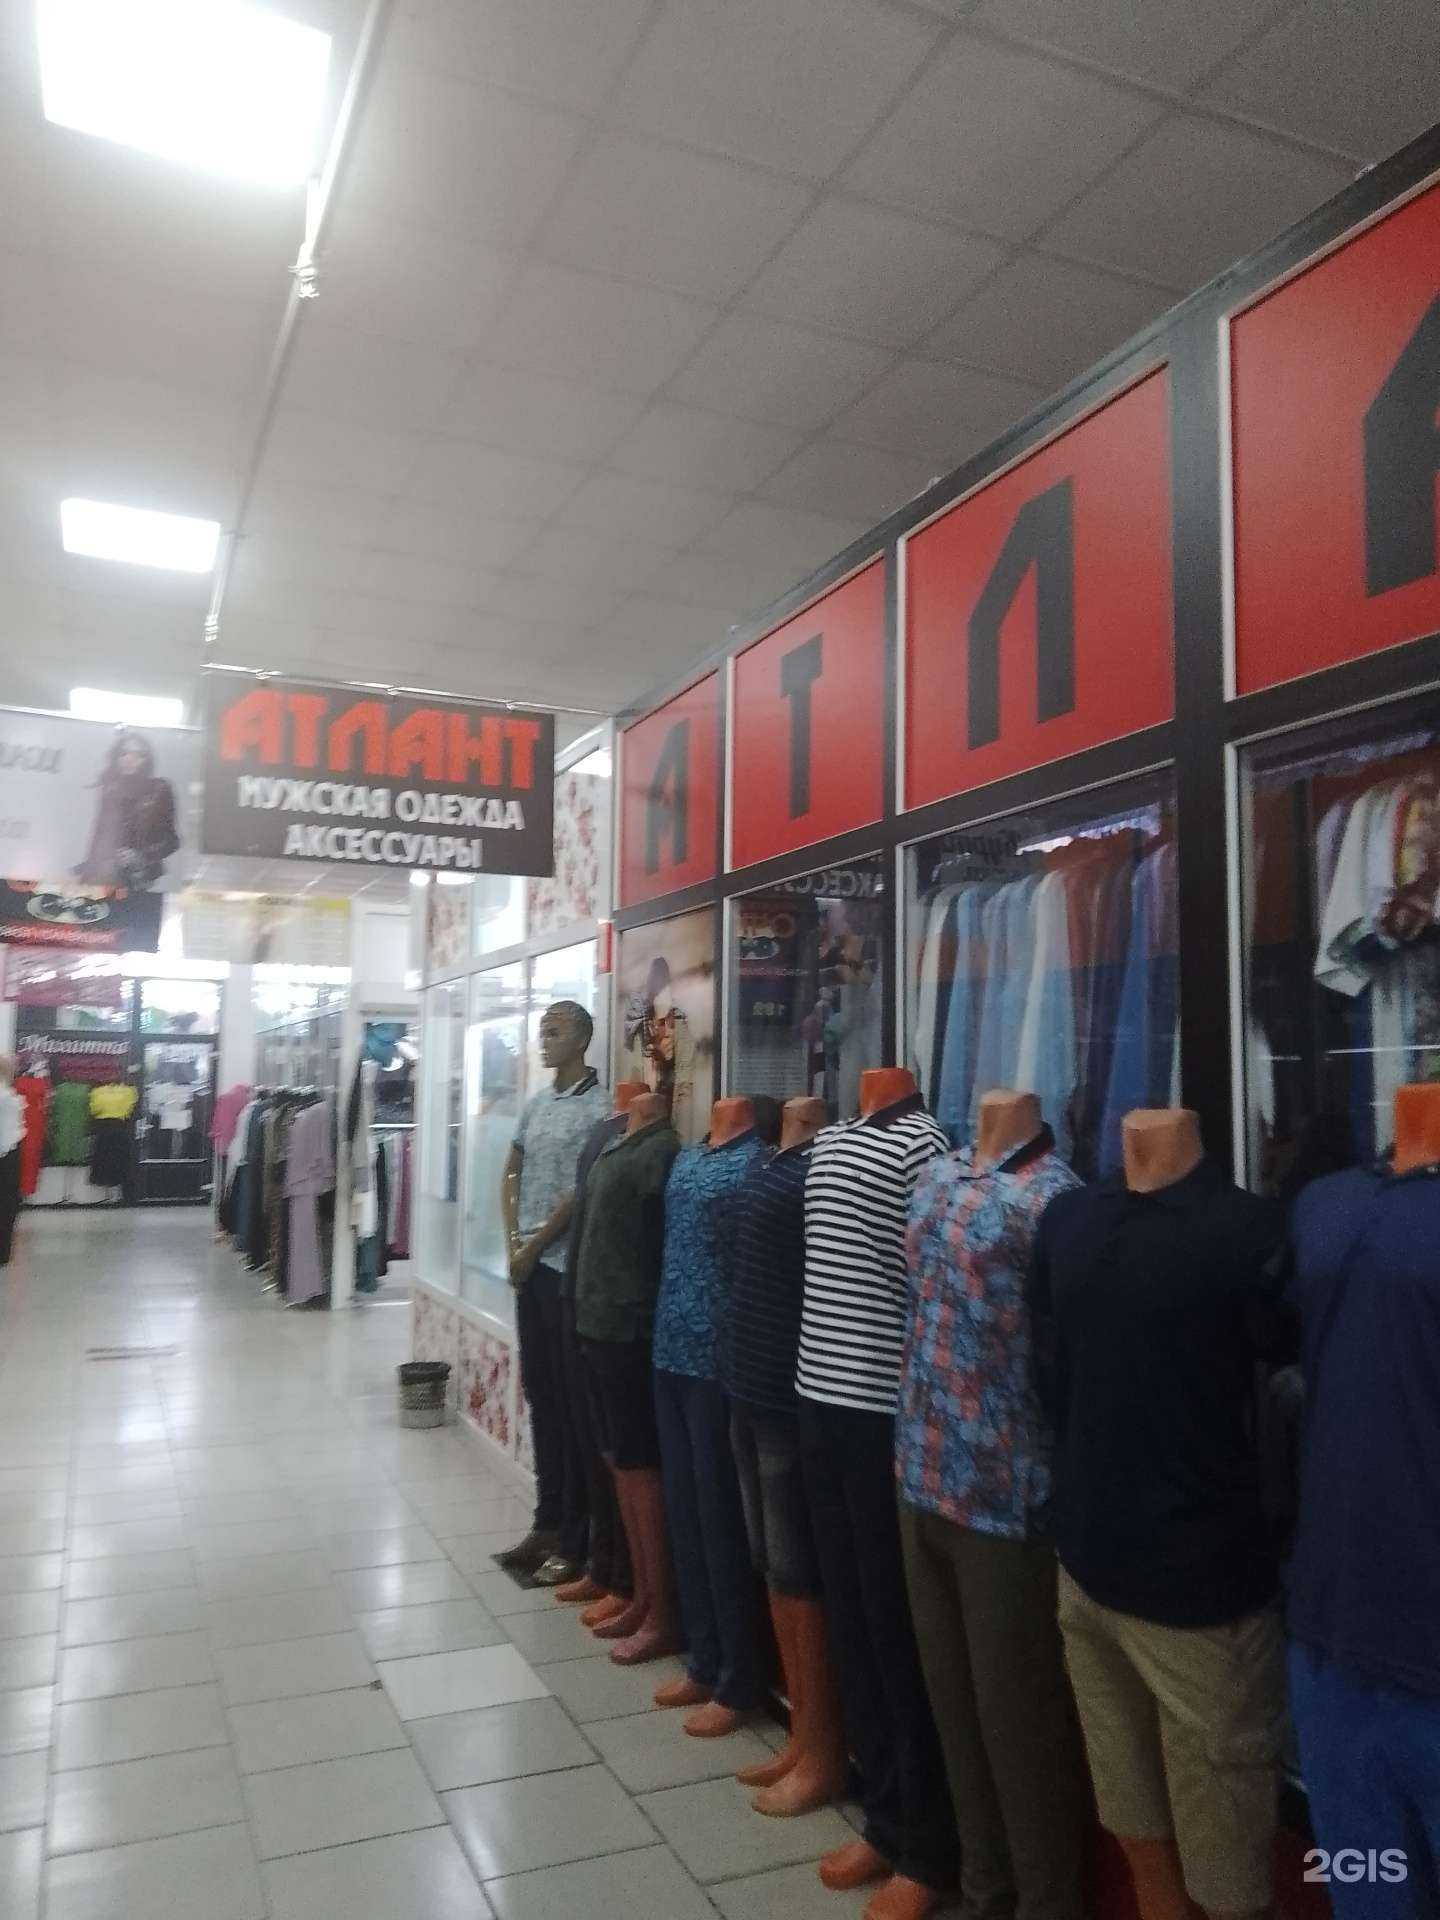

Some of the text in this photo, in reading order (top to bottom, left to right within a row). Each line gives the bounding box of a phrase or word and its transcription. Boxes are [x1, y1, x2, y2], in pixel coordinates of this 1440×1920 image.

[220, 690, 541, 789] АТЛАНТ
[238, 775, 525, 830] МУЖСКАЯ ОДЕЖДА
[283, 824, 483, 868] АКСЕССУАРЫ
